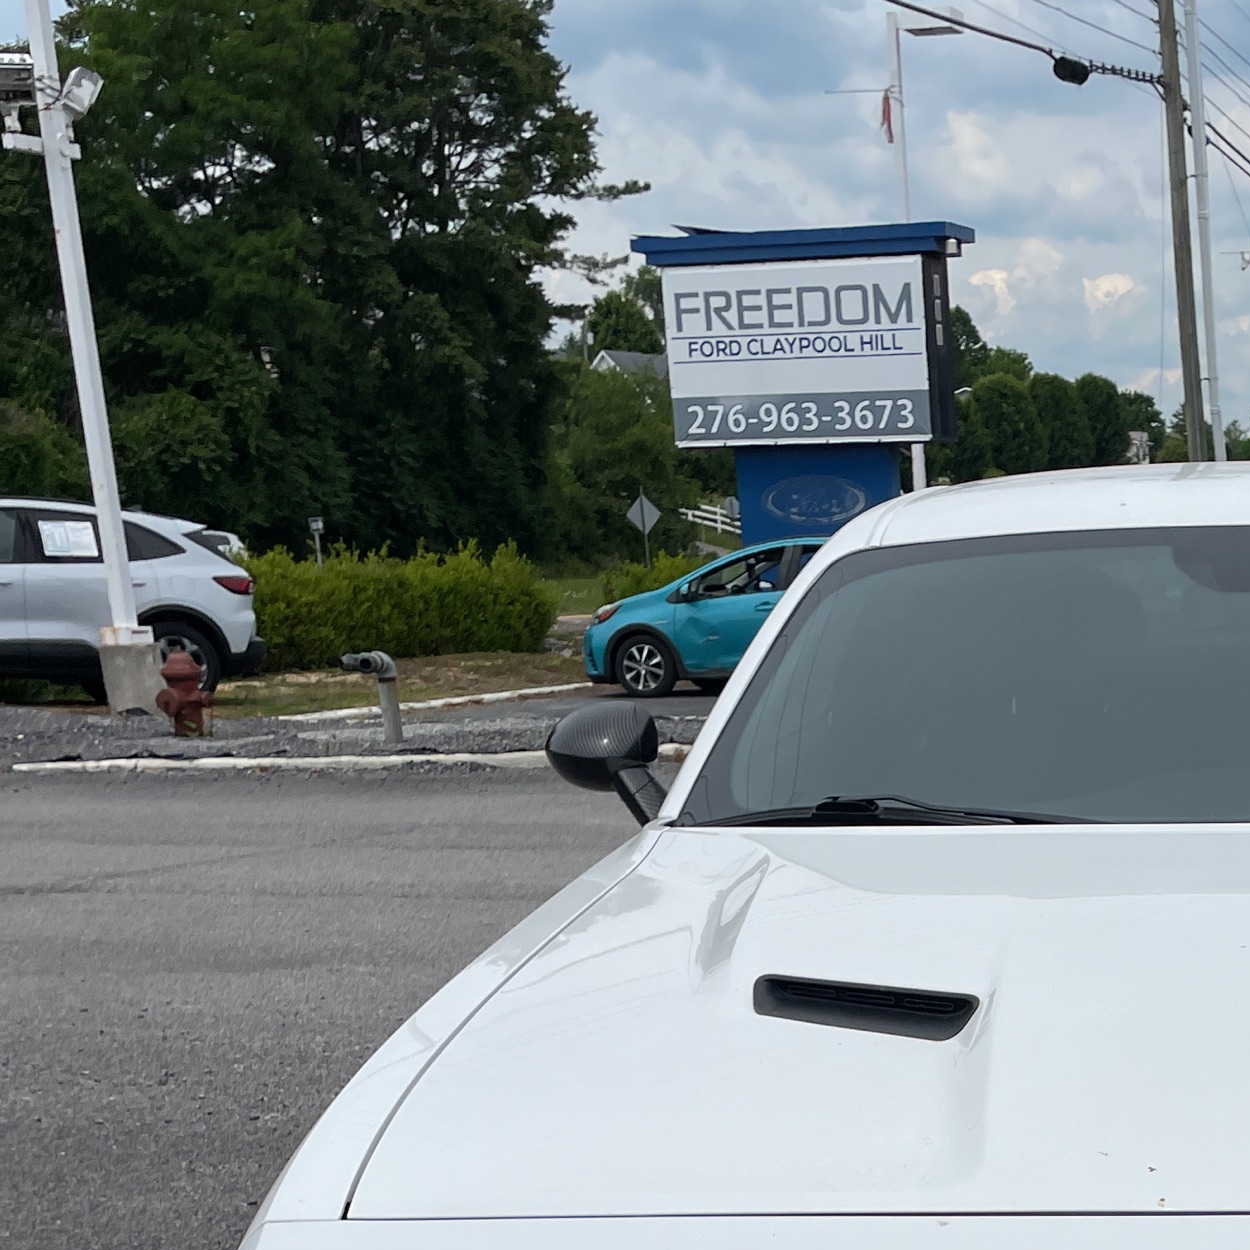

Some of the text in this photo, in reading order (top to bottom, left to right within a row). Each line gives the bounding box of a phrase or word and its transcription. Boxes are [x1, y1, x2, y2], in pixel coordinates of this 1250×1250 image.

[673, 281, 914, 333] FREEDOM
[688, 333, 904, 358] FORD CLAYPOOL HILL
[686, 398, 915, 434] 276-963-3673
